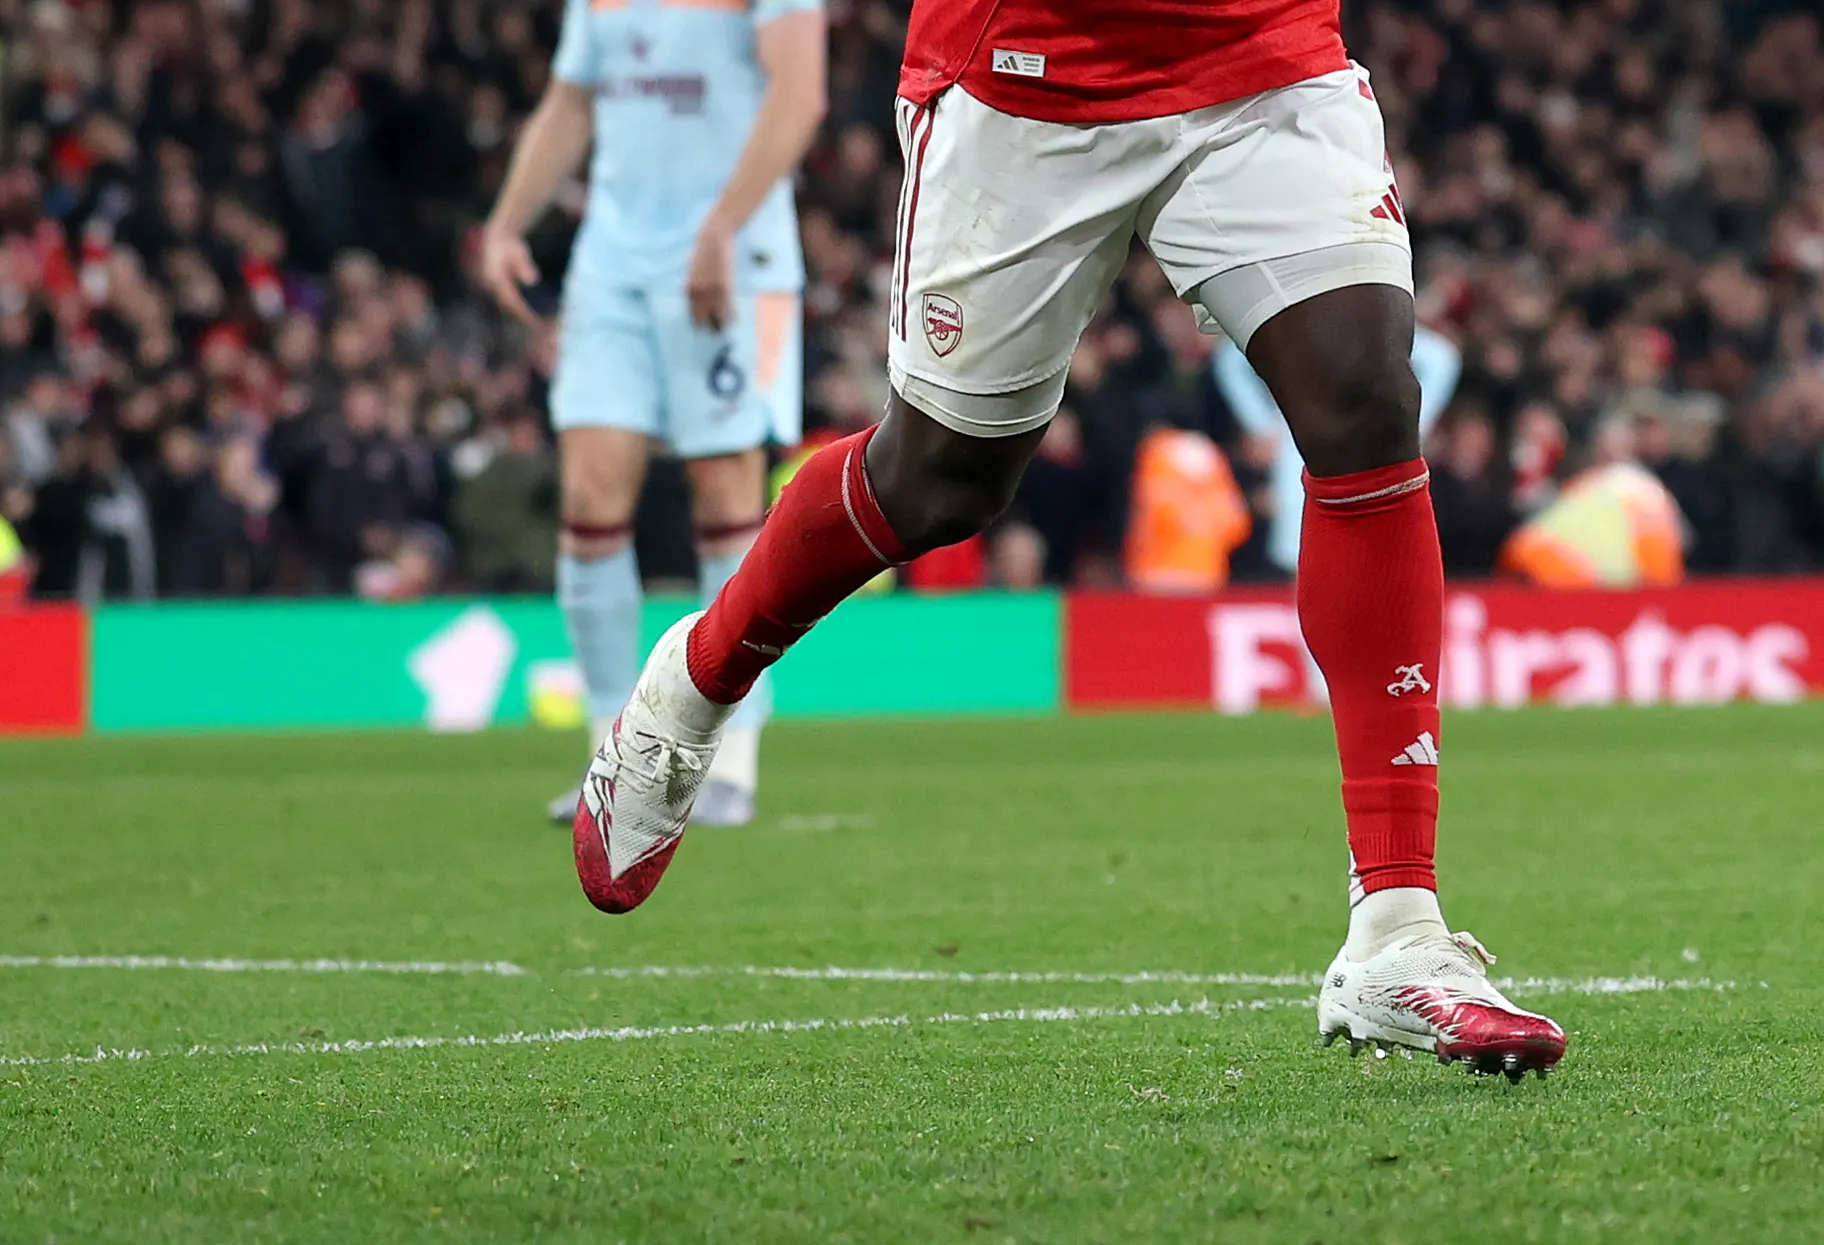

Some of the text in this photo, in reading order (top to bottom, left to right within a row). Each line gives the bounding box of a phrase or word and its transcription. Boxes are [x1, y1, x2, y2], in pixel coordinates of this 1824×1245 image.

[927, 302, 959, 320] Arsenal
[707, 340, 745, 402] 6
[1206, 594, 1808, 714] Eirates
